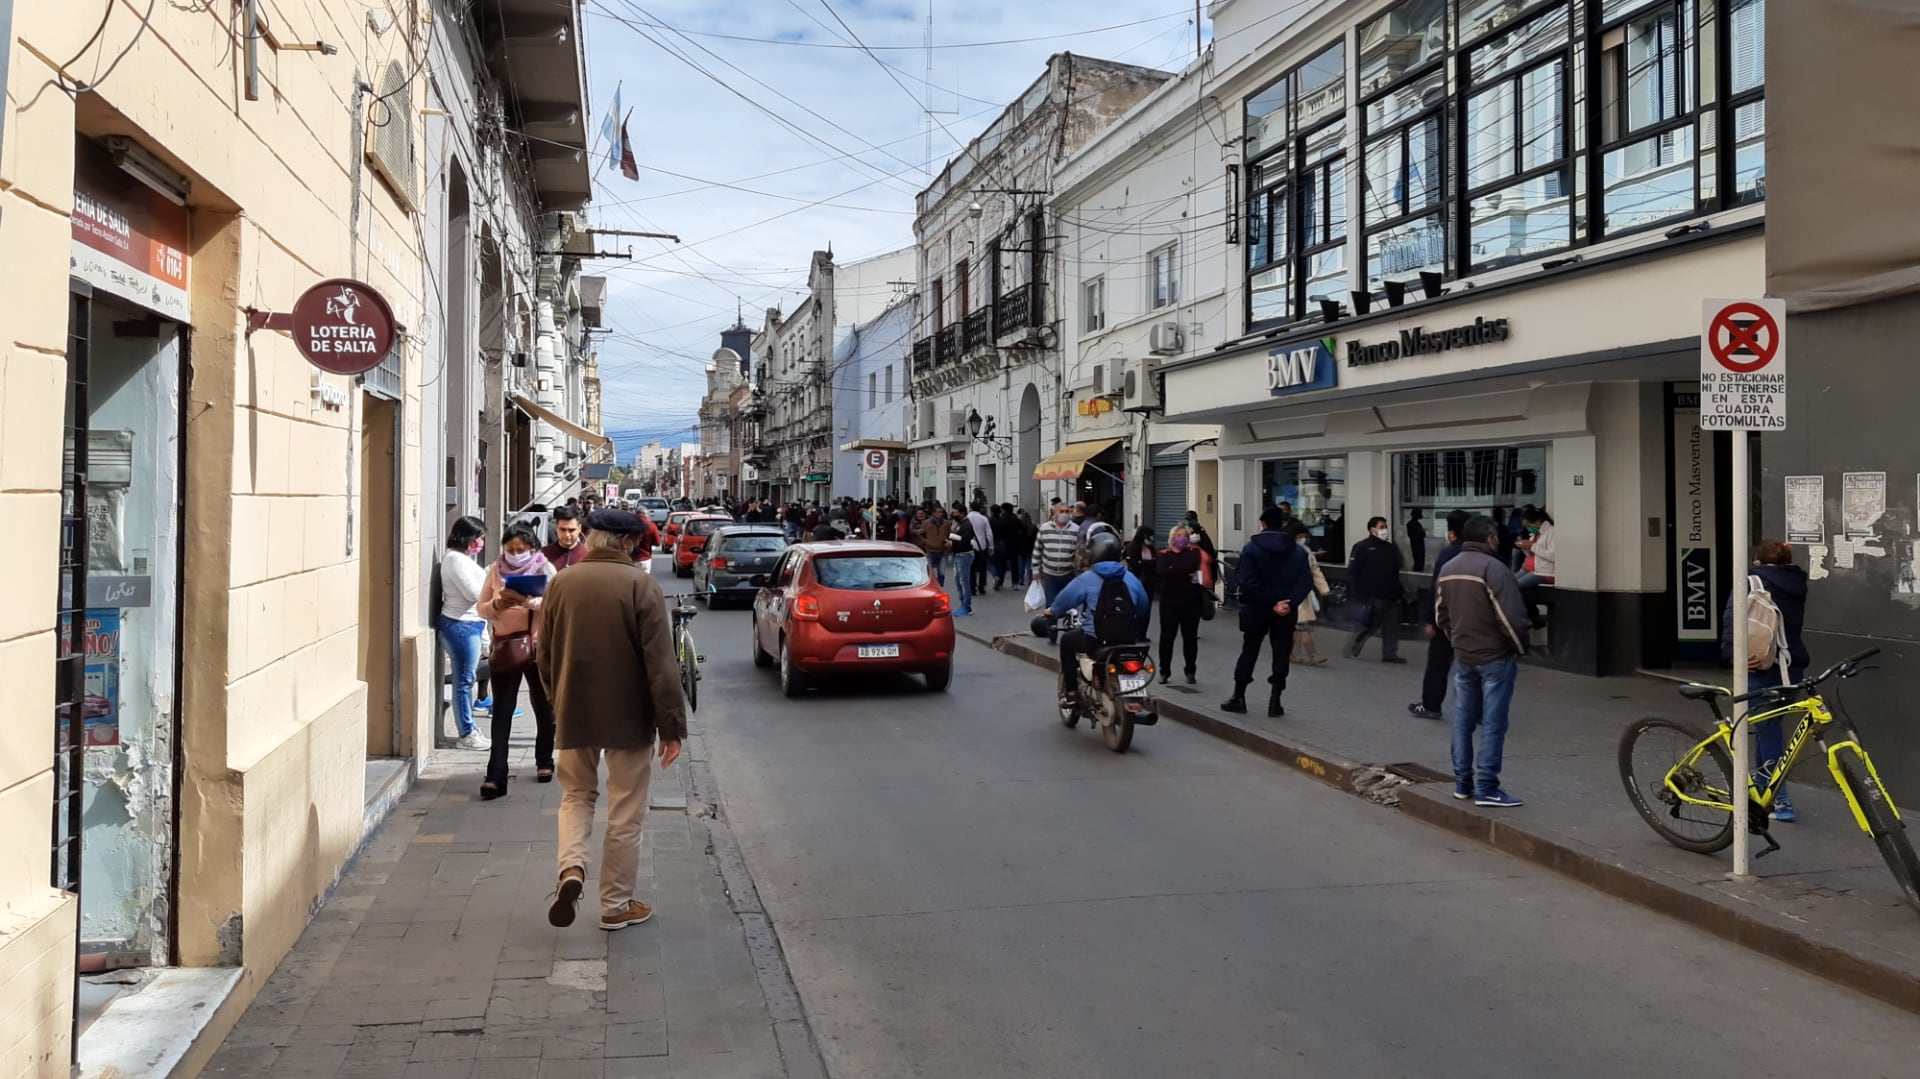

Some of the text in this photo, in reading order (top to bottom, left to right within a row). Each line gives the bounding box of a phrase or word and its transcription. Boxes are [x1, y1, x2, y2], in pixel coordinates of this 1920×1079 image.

[96, 201, 108, 227] DE
[108, 208, 130, 238] SALTA
[310, 323, 376, 339] LOTERÍA
[311, 340, 376, 353] DE SALTA
[1266, 316, 1509, 391] BMV Banco Masventas
[1702, 372, 1785, 383] NO ESTACIONAR
[1702, 383, 1785, 393] NI DETENERSE
[1711, 394, 1774, 404] EN ESTA
[1715, 404, 1770, 414] CUADRA
[1701, 414, 1785, 427] FOTOMULTAS
[871, 453, 881, 465] E
[1688, 424, 1702, 542] Banco Masventas
[1687, 560, 1706, 621] BMV
